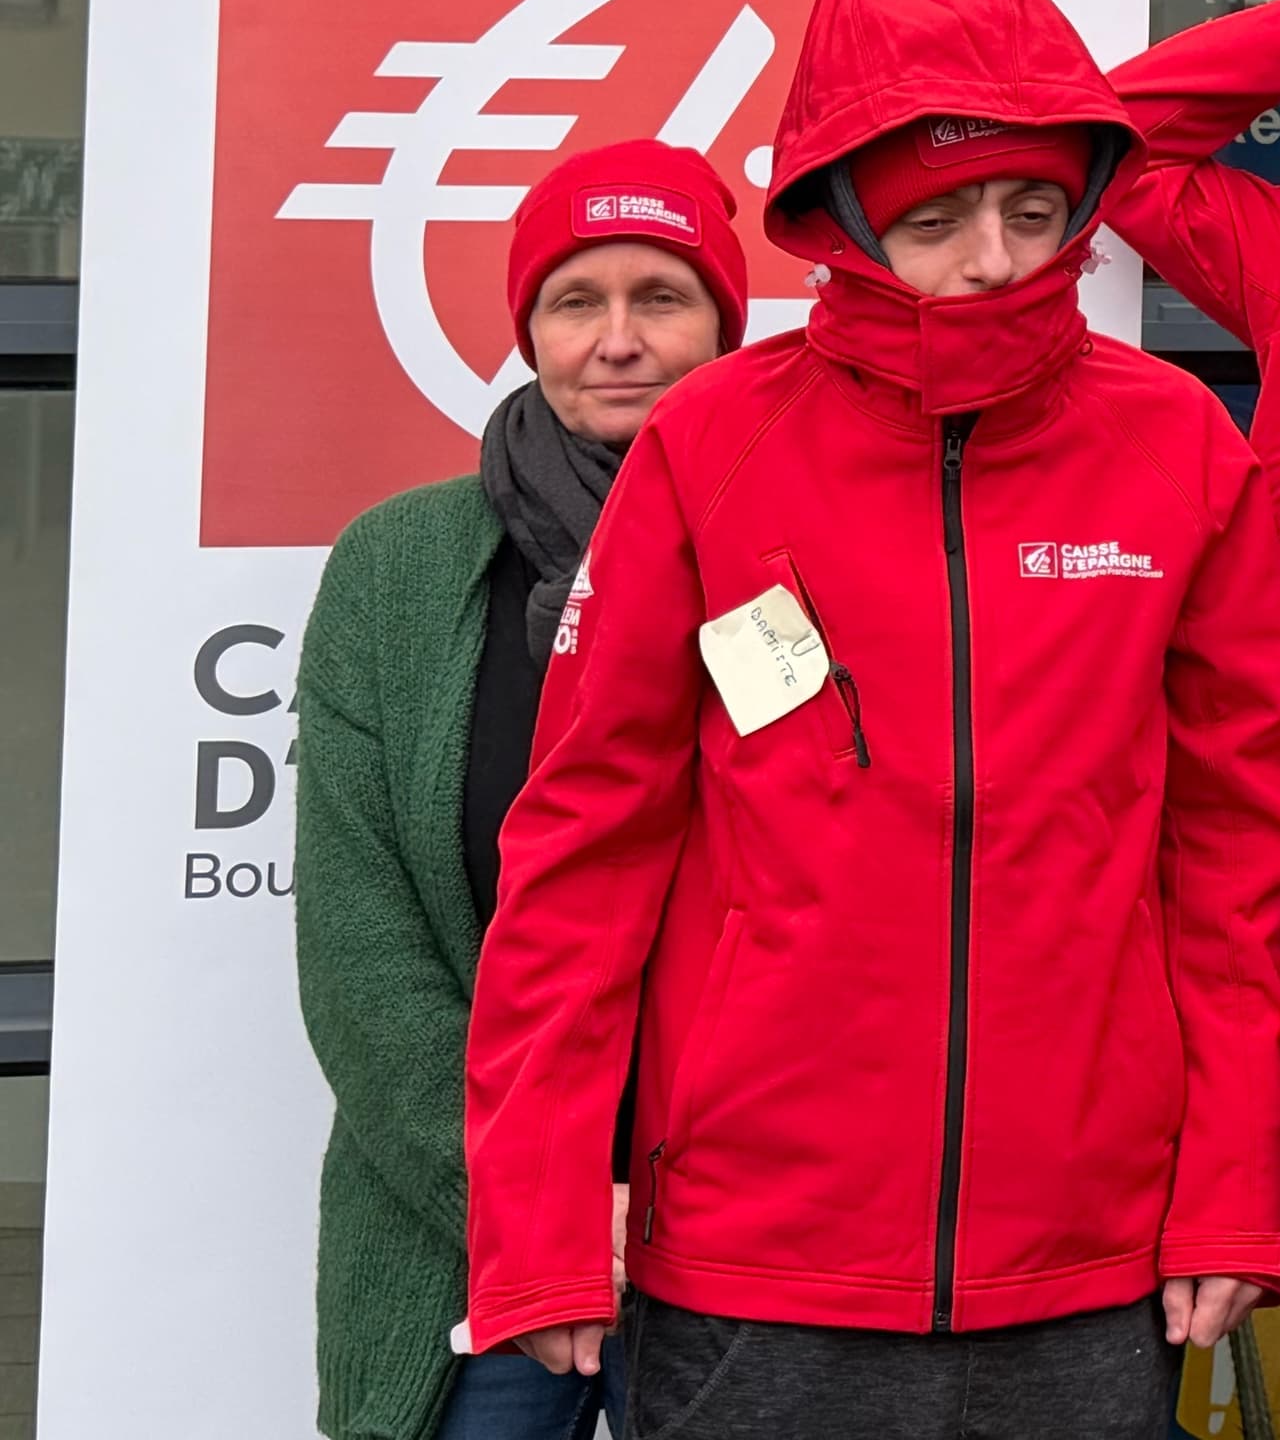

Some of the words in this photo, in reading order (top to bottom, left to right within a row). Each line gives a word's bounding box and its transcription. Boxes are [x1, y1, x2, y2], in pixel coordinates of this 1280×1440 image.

[619, 195, 665, 209] CAISSE
[1061, 541, 1119, 558] CAISSE
[1062, 554, 1152, 571] D'EPARGNE
